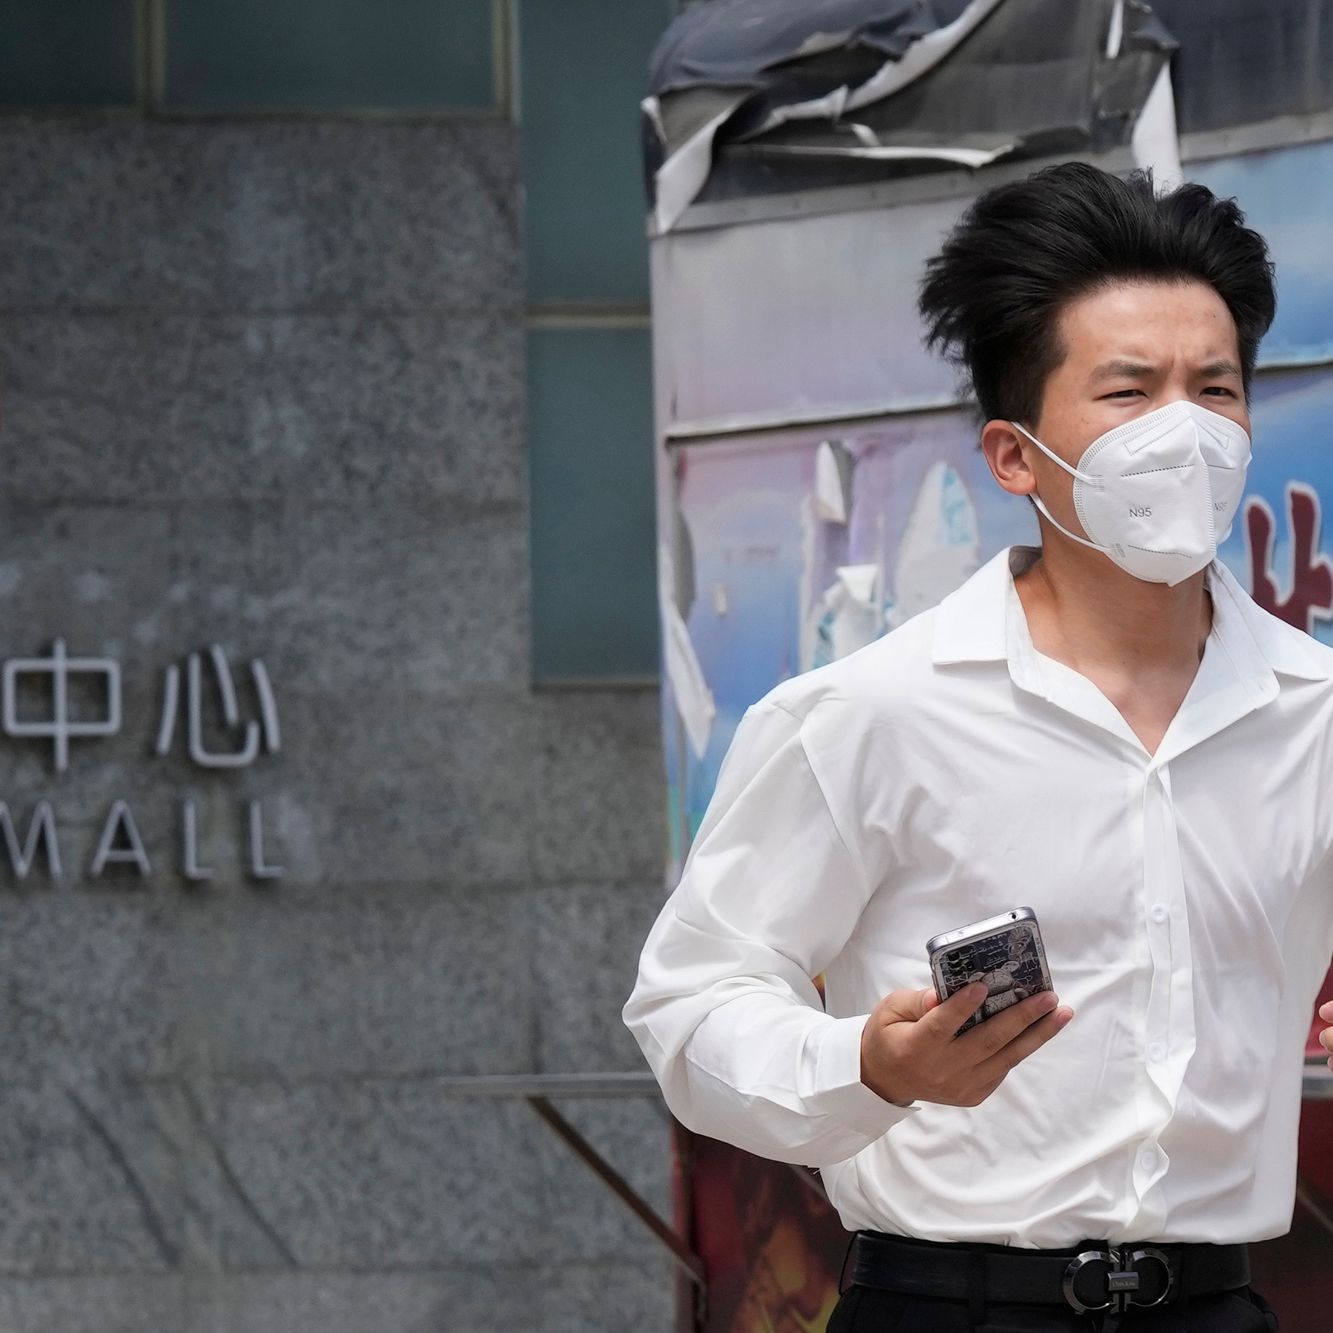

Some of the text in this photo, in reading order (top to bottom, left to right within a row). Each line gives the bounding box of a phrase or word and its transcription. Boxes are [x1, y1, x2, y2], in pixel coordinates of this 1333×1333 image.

[1129, 507, 1152, 518] N95
[4, 638, 281, 770] 中心
[0, 800, 286, 880] MALL
